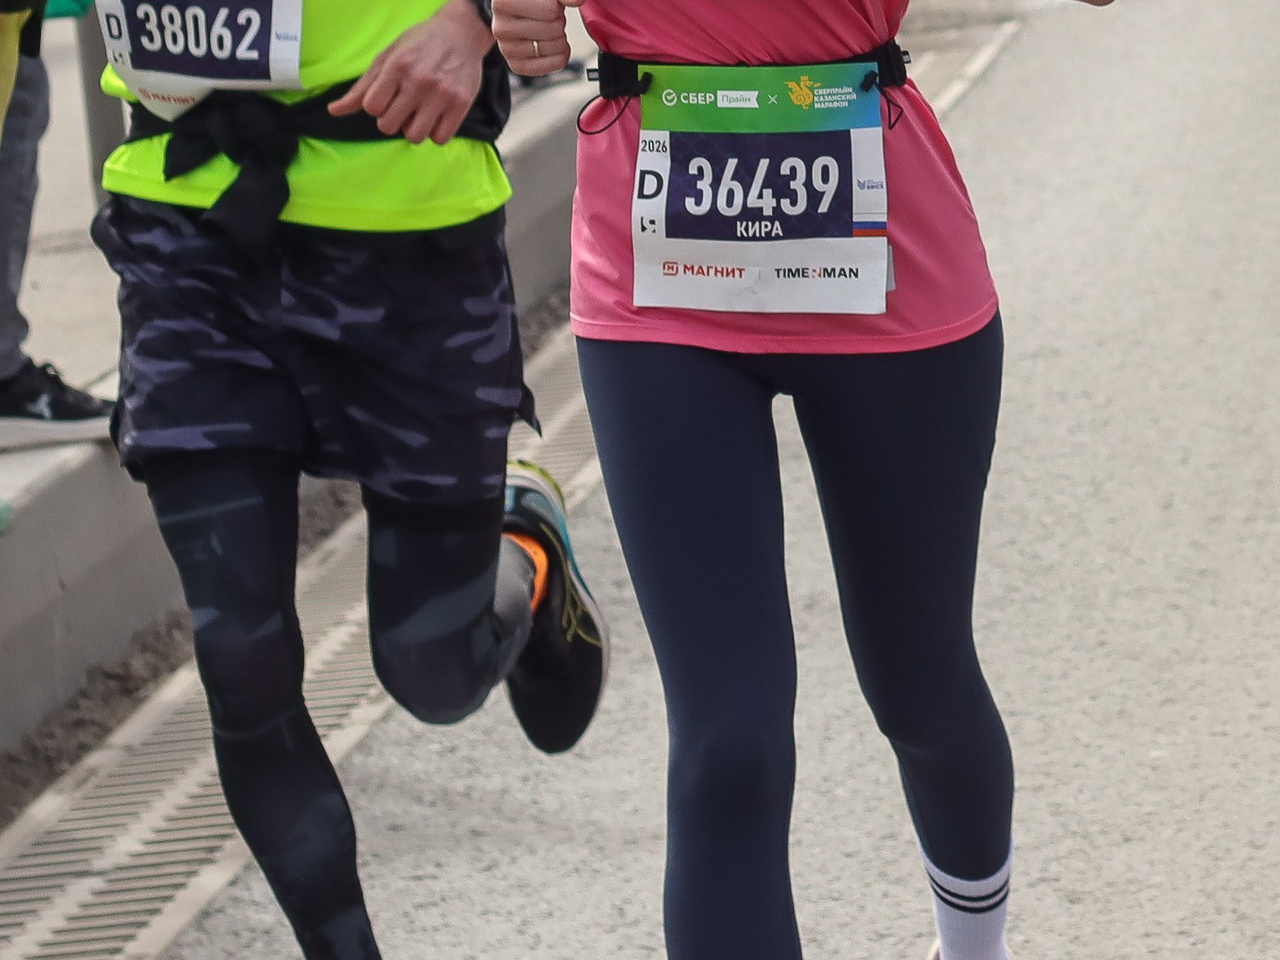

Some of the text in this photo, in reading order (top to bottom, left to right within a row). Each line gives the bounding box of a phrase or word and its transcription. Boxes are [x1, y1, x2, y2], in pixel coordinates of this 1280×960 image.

[105, 13, 122, 39] D
[135, 3, 261, 60] 38062
[680, 92, 715, 105] СБЕР
[641, 139, 668, 153] 2026
[637, 169, 664, 200] D
[684, 155, 840, 217] 36439
[736, 220, 784, 238] КИРА
[683, 263, 746, 279] МАГНИТ
